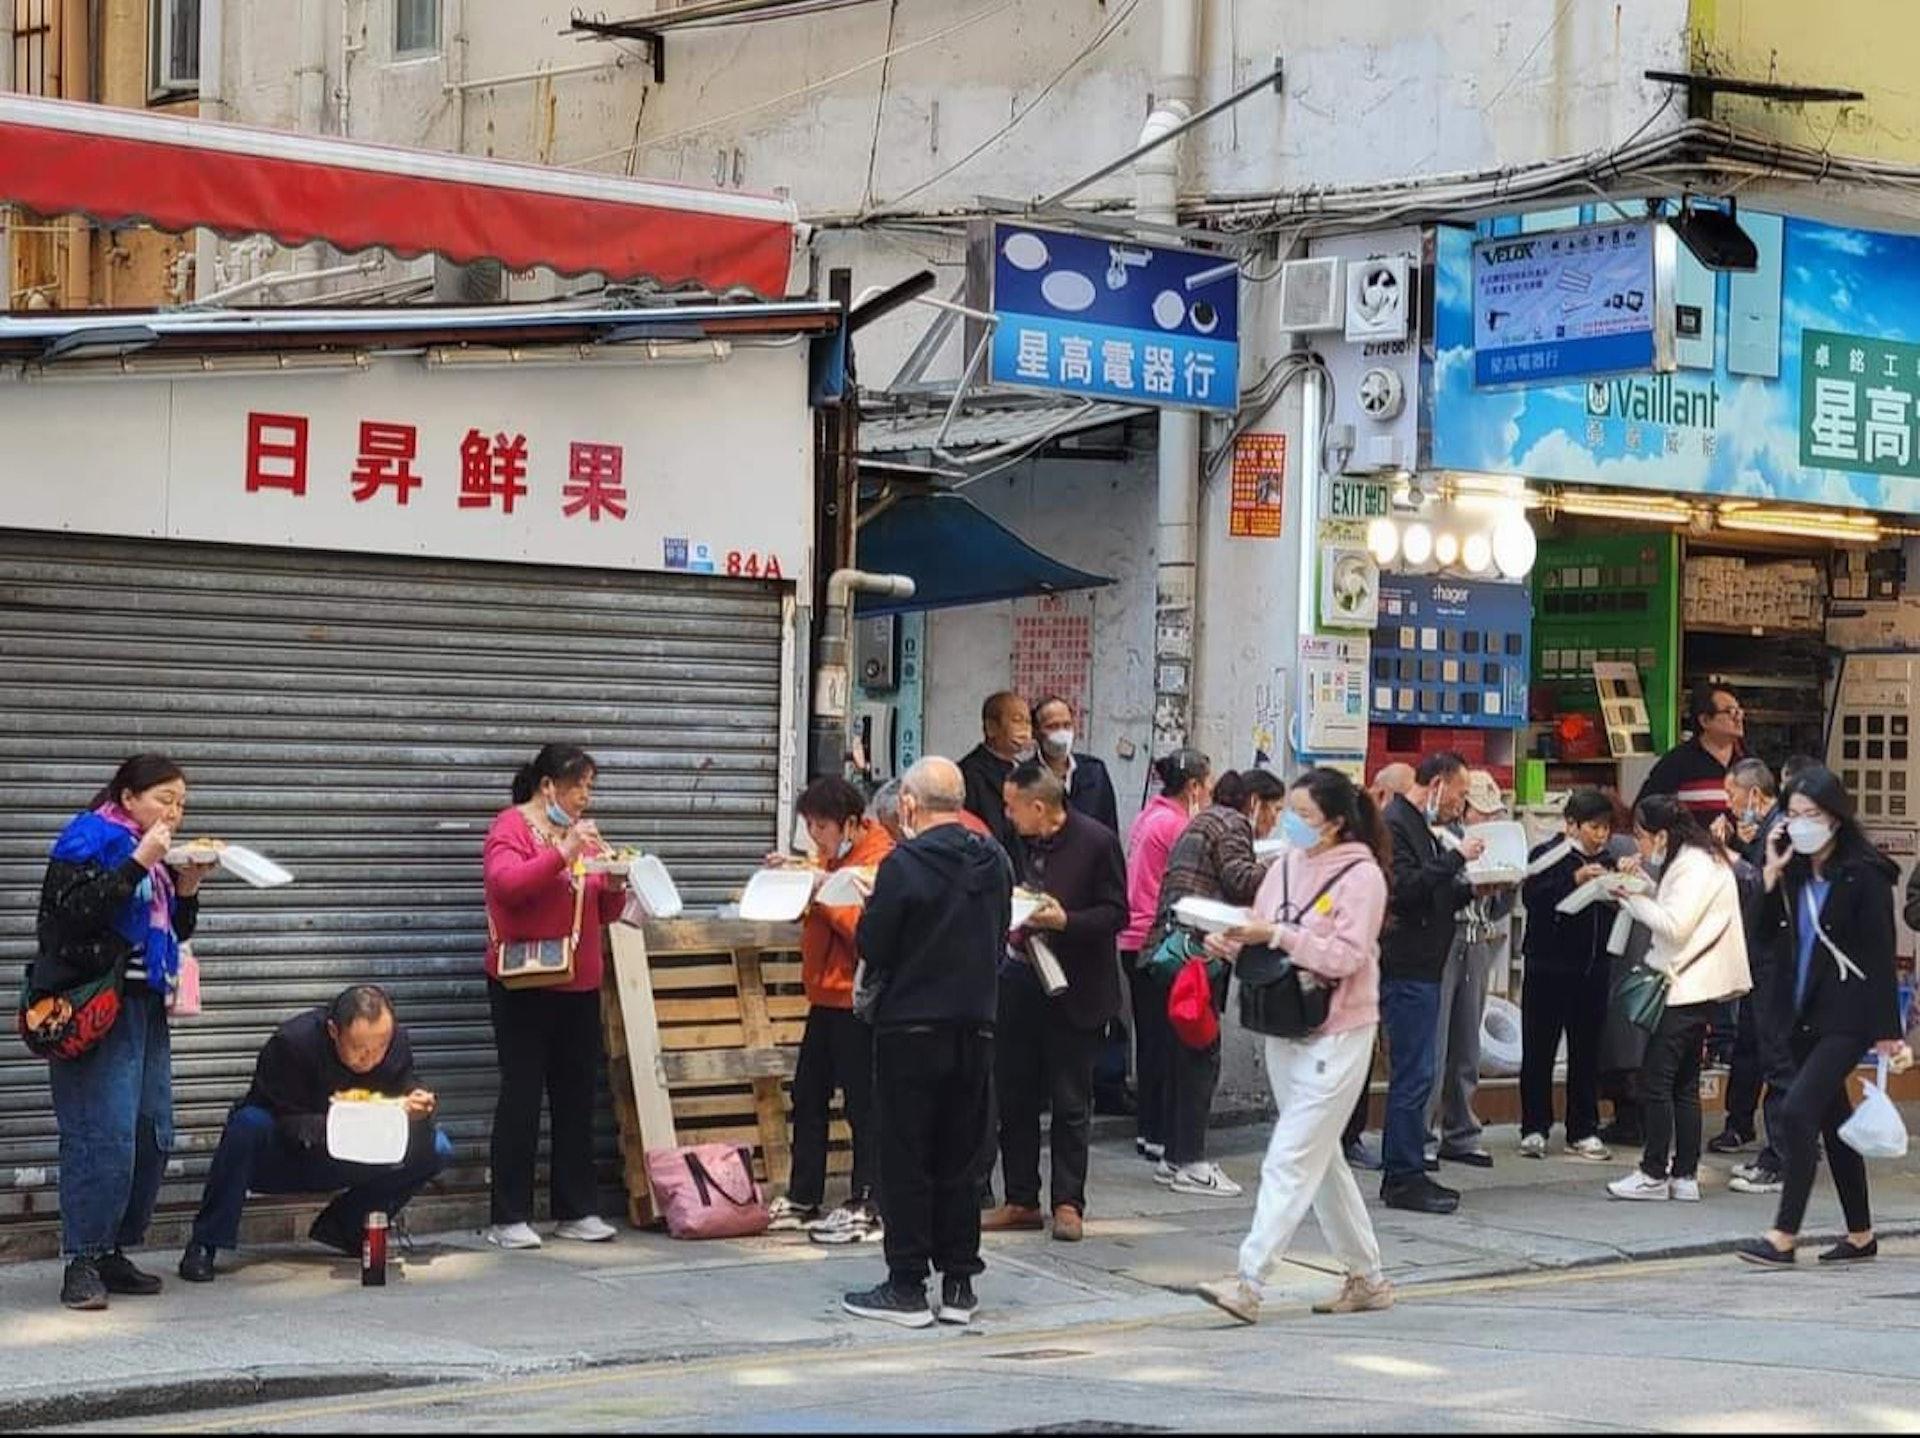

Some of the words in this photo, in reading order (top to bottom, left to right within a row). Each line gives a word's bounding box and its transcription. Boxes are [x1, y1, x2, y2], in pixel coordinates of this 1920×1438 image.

[1016, 328, 1215, 398] 星高電器行
[1615, 374, 1720, 428] Vaillant
[1811, 377, 1920, 466] 星高
[727, 551, 783, 582] 84A
